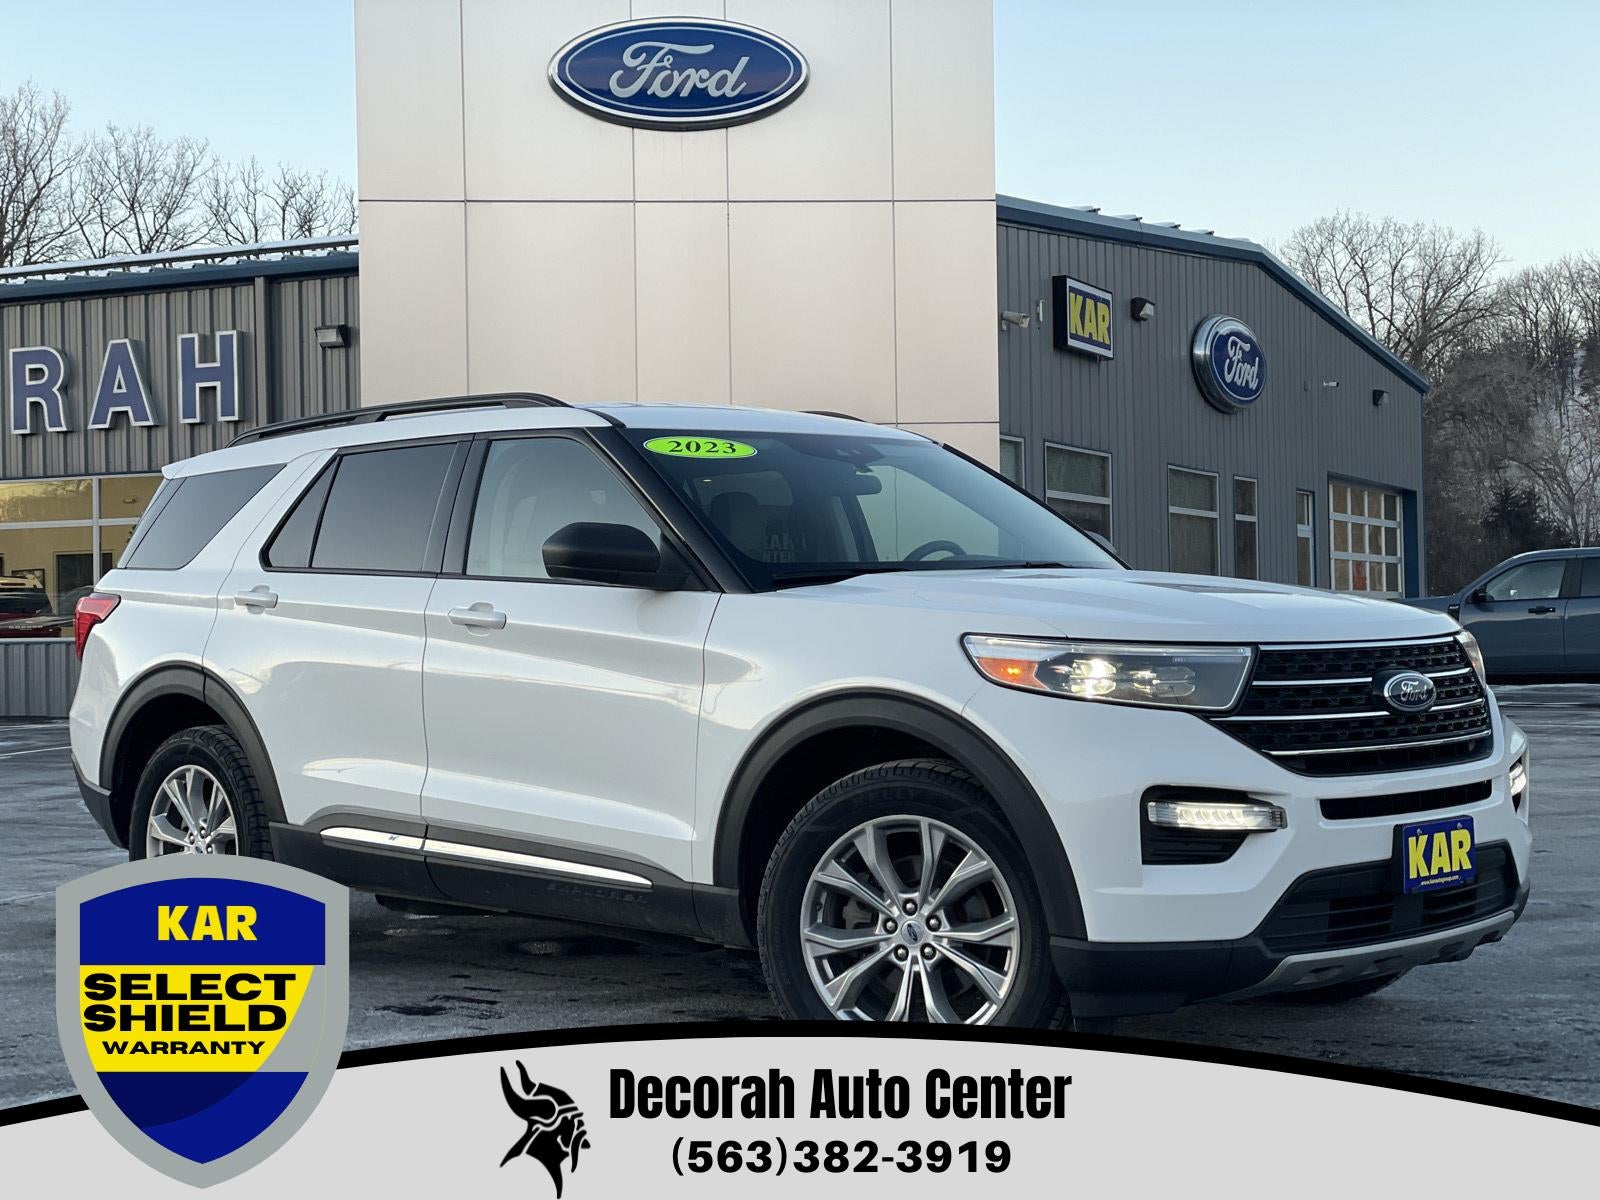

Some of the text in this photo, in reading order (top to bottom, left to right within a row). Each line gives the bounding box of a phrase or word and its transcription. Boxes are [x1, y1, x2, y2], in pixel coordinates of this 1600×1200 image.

[609, 41, 750, 98] Ford
[1069, 291, 1111, 345] KAR
[9, 329, 243, 435] RAH
[1224, 336, 1259, 390] Ford
[667, 440, 737, 454] 2023
[1401, 680, 1428, 702] Ford
[1408, 828, 1472, 879] KAR
